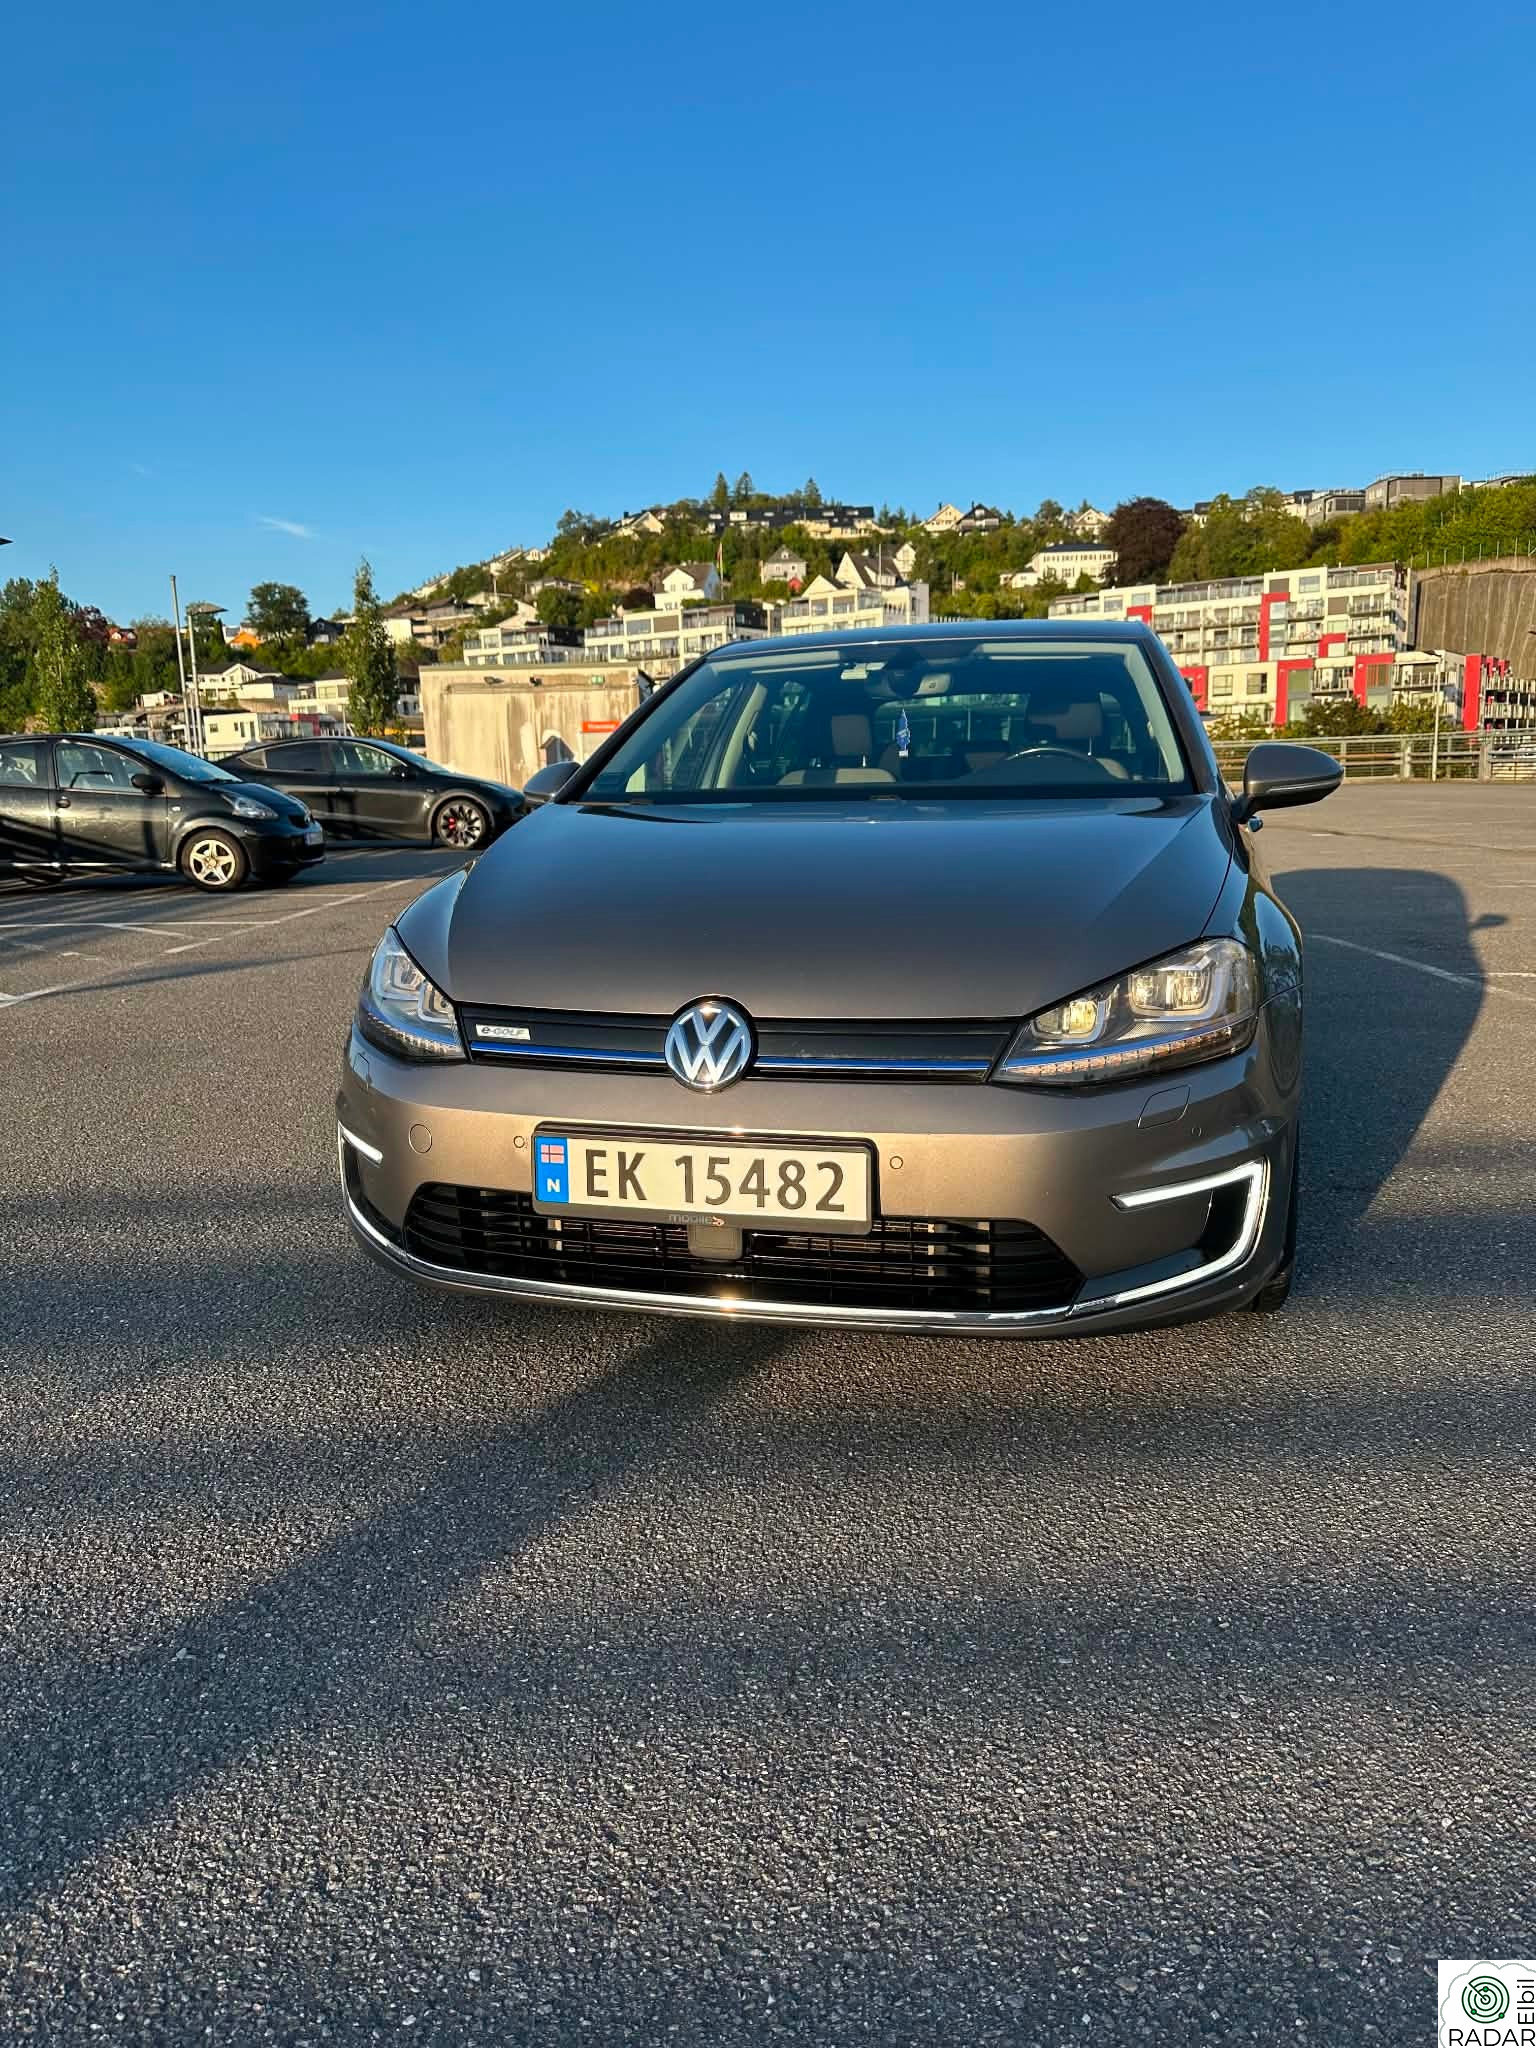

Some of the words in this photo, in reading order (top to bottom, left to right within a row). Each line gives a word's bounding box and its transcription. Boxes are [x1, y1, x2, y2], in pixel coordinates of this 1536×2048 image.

[546, 1178, 561, 1193] N
[585, 1148, 648, 1201] EK
[674, 1154, 845, 1213] 15482
